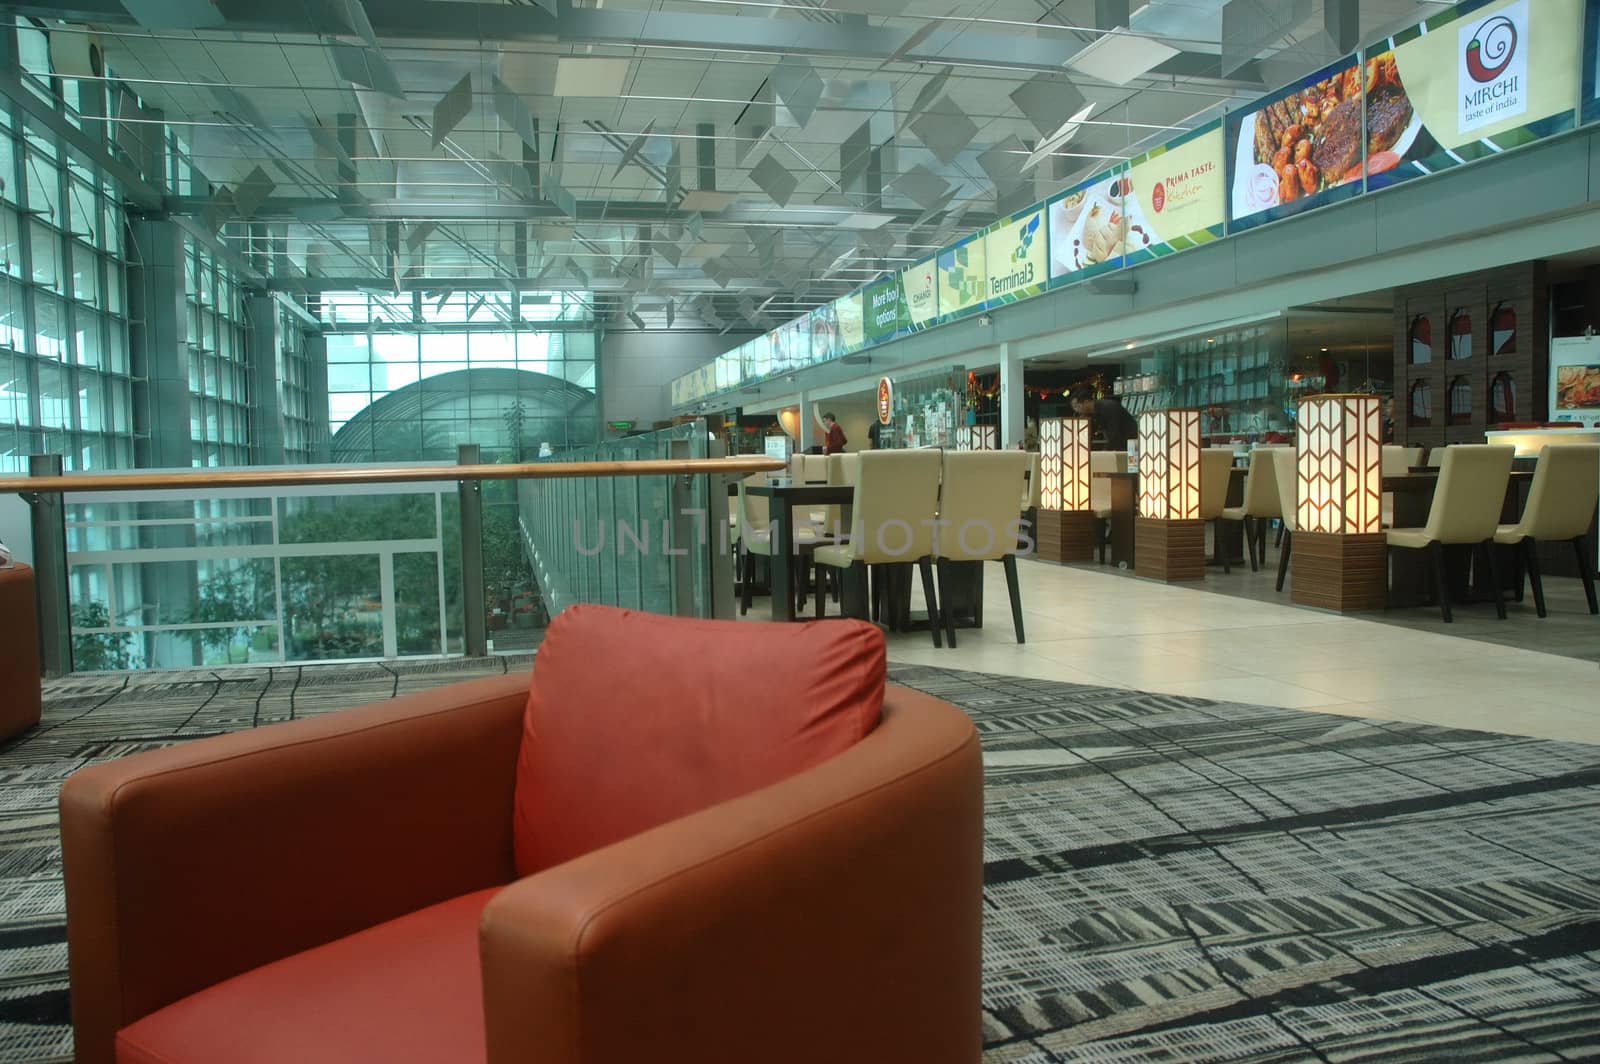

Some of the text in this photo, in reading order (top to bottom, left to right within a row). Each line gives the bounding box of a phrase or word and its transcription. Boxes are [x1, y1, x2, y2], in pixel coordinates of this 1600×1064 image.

[1465, 76, 1518, 109] MIRCHI
[1465, 97, 1517, 121] taste of india
[1166, 172, 1189, 188] PRIMA
[872, 293, 886, 309] More
[876, 309, 896, 328] options
